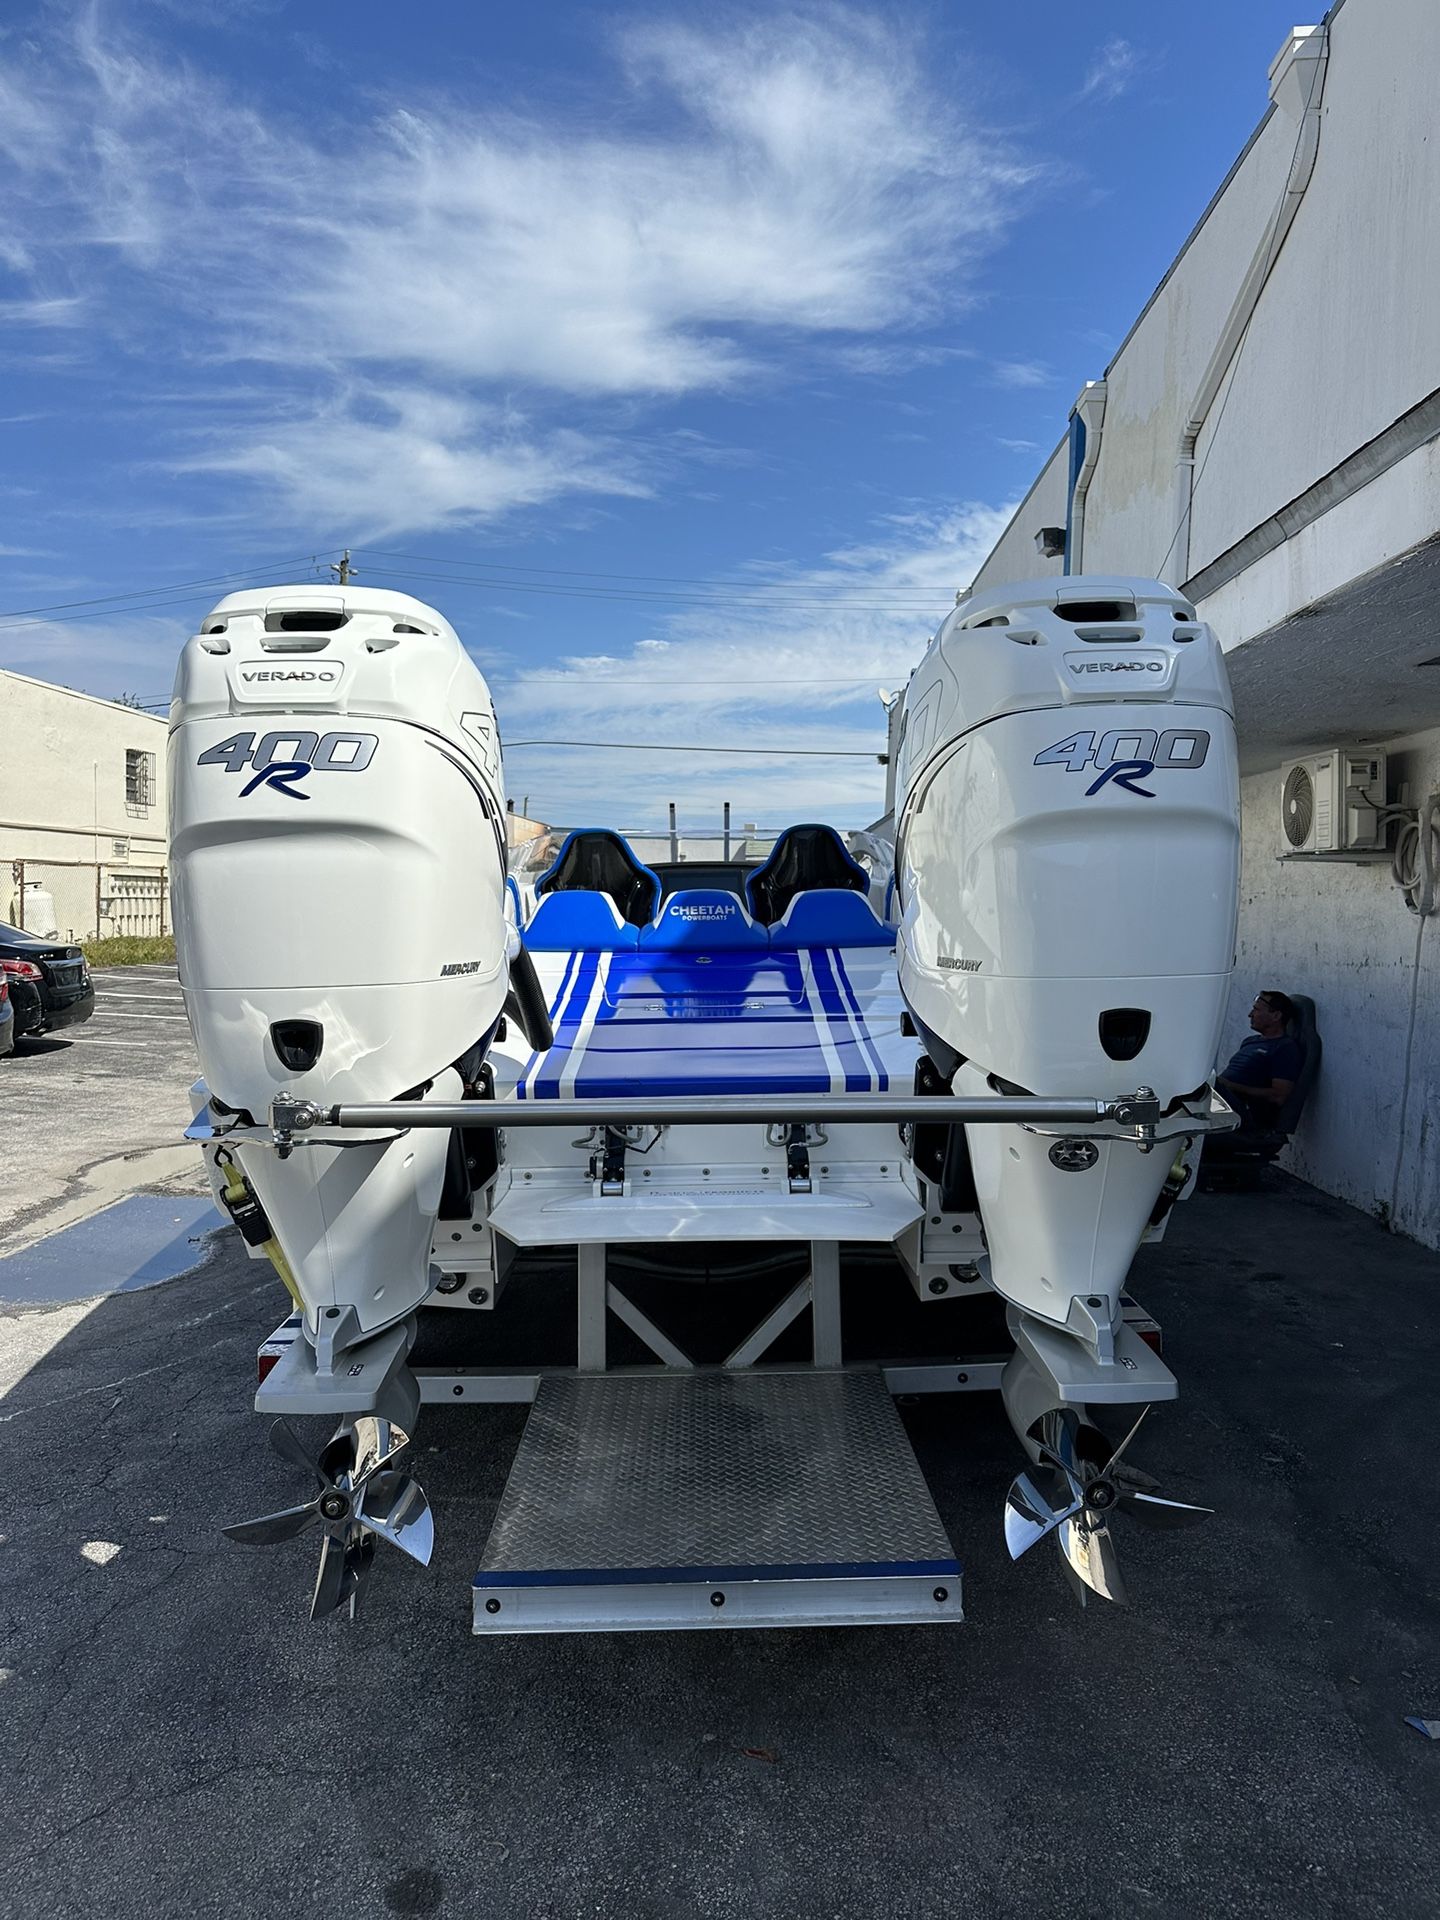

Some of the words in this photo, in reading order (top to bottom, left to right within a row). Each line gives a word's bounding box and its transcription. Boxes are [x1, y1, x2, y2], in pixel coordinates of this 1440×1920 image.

[1069, 661, 1163, 673] VERADO
[242, 671, 336, 682] VERADO
[197, 731, 380, 773] 400
[1033, 728, 1211, 772] 400
[238, 761, 313, 801] R
[1085, 759, 1157, 798] R
[670, 905, 736, 916] CHEETAH
[440, 960, 481, 977] MERCURY
[936, 955, 983, 972] MERCURY
